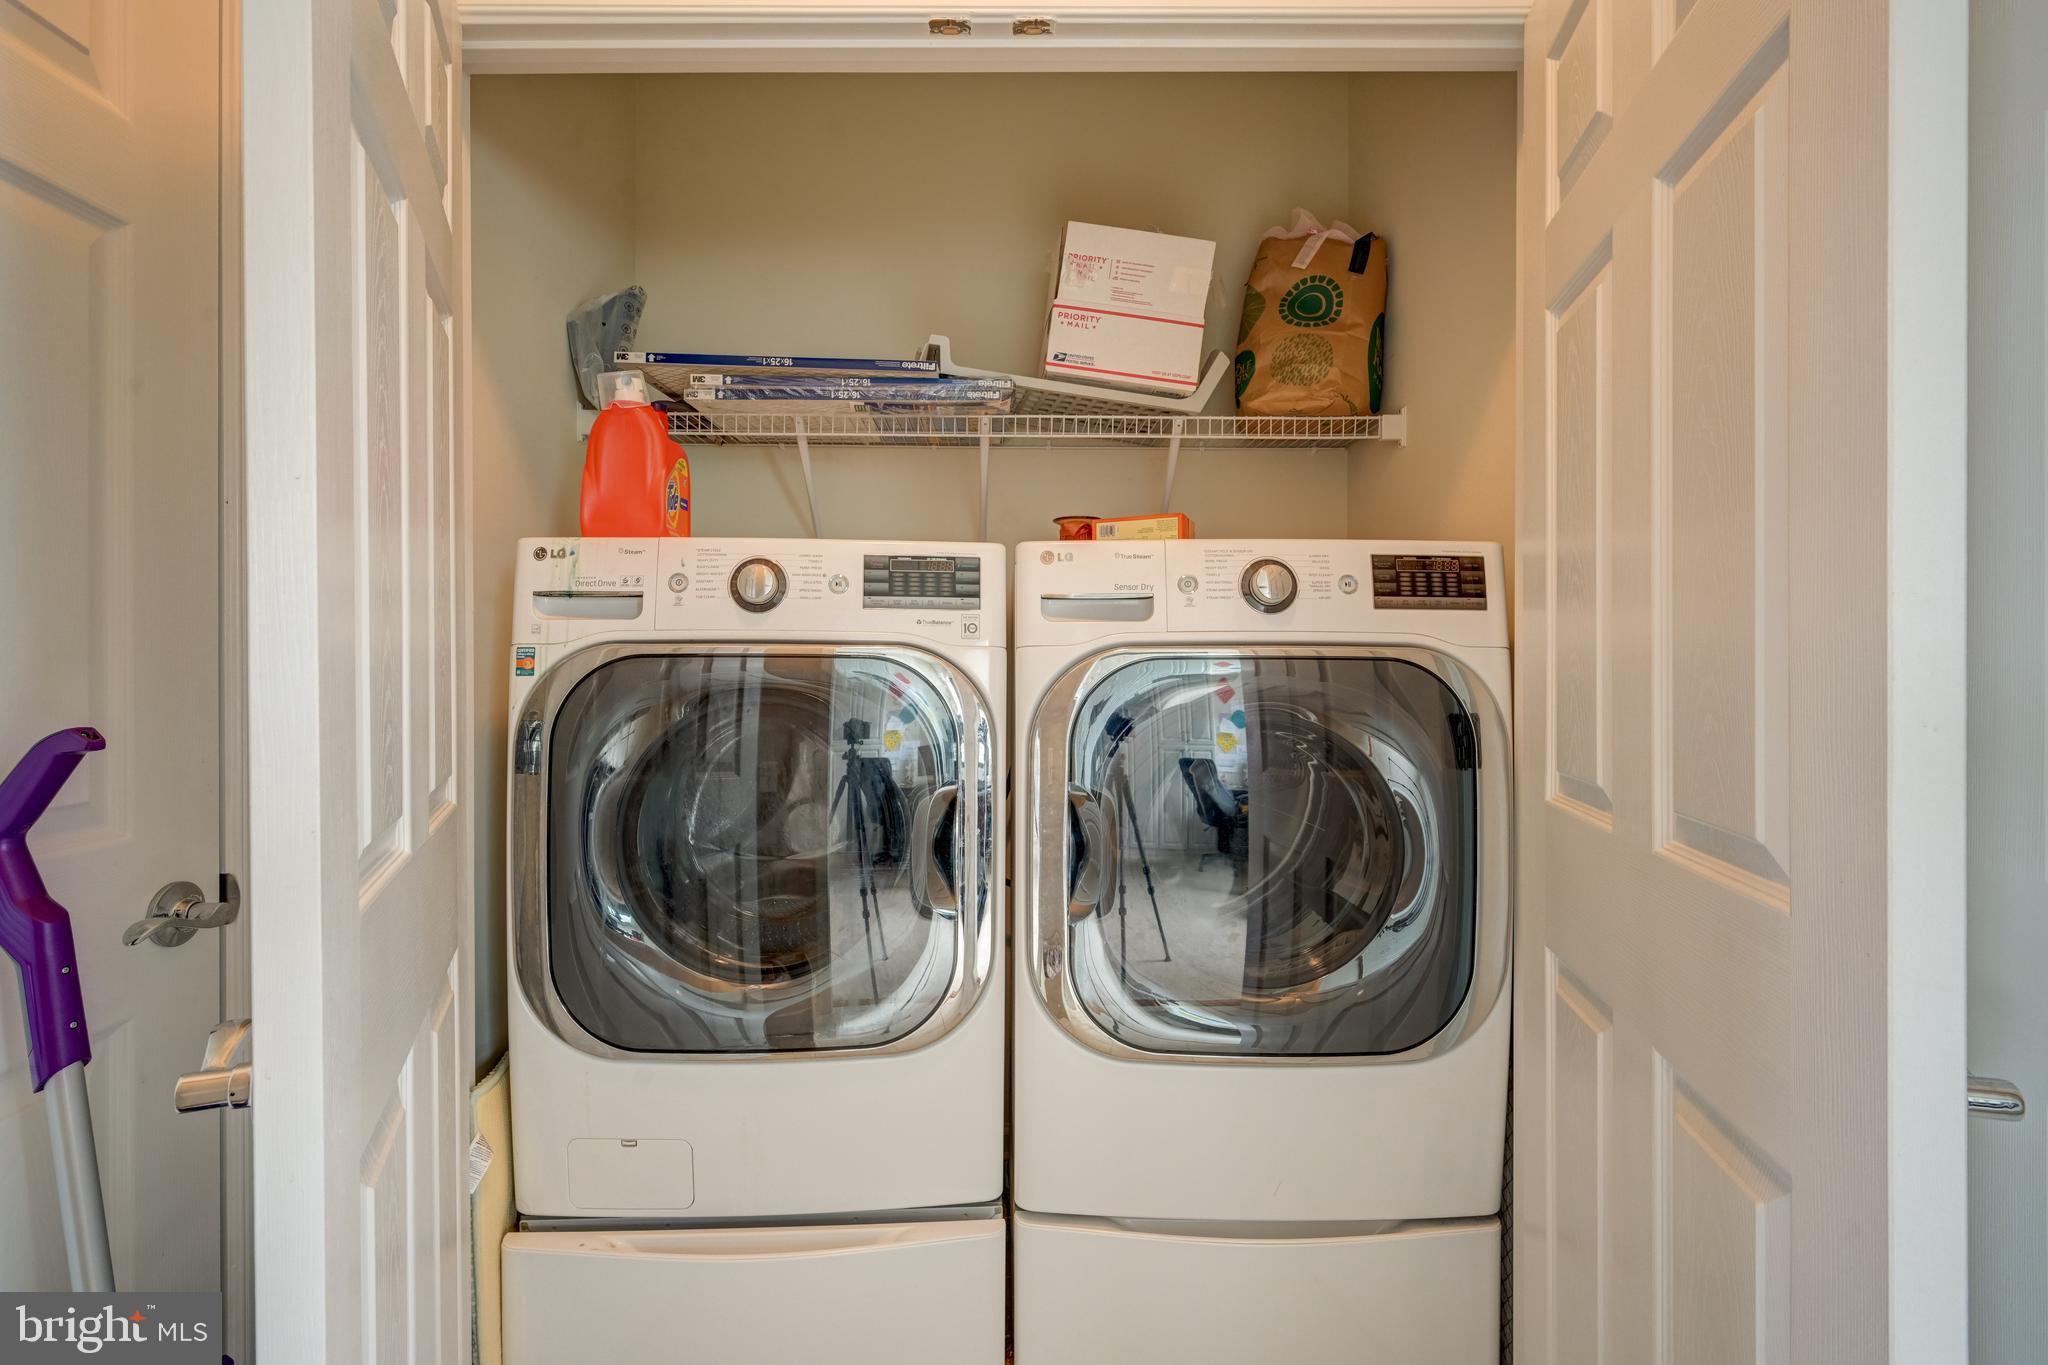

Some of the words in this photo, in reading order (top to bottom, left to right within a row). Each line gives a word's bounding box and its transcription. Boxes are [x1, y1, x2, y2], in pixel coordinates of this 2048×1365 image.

[1067, 253, 1107, 264] PRIORITY
[1057, 311, 1101, 324] PRIORITY
[1066, 321, 1089, 330] MAIL
[616, 353, 629, 361] 3M
[762, 358, 793, 366] 16x25x1
[901, 362, 936, 371] Filtrete
[692, 375, 706, 383] 3M
[841, 377, 872, 386] 16x25x1
[978, 379, 1012, 388] Filtrete
[667, 484, 679, 511] Tide
[550, 548, 566, 559] LG
[1057, 552, 1074, 562] LG
[575, 579, 597, 587] Direct
[597, 579, 617, 587] Drive
[1114, 583, 1138, 591] Sensor
[1140, 583, 1154, 593] Dry
